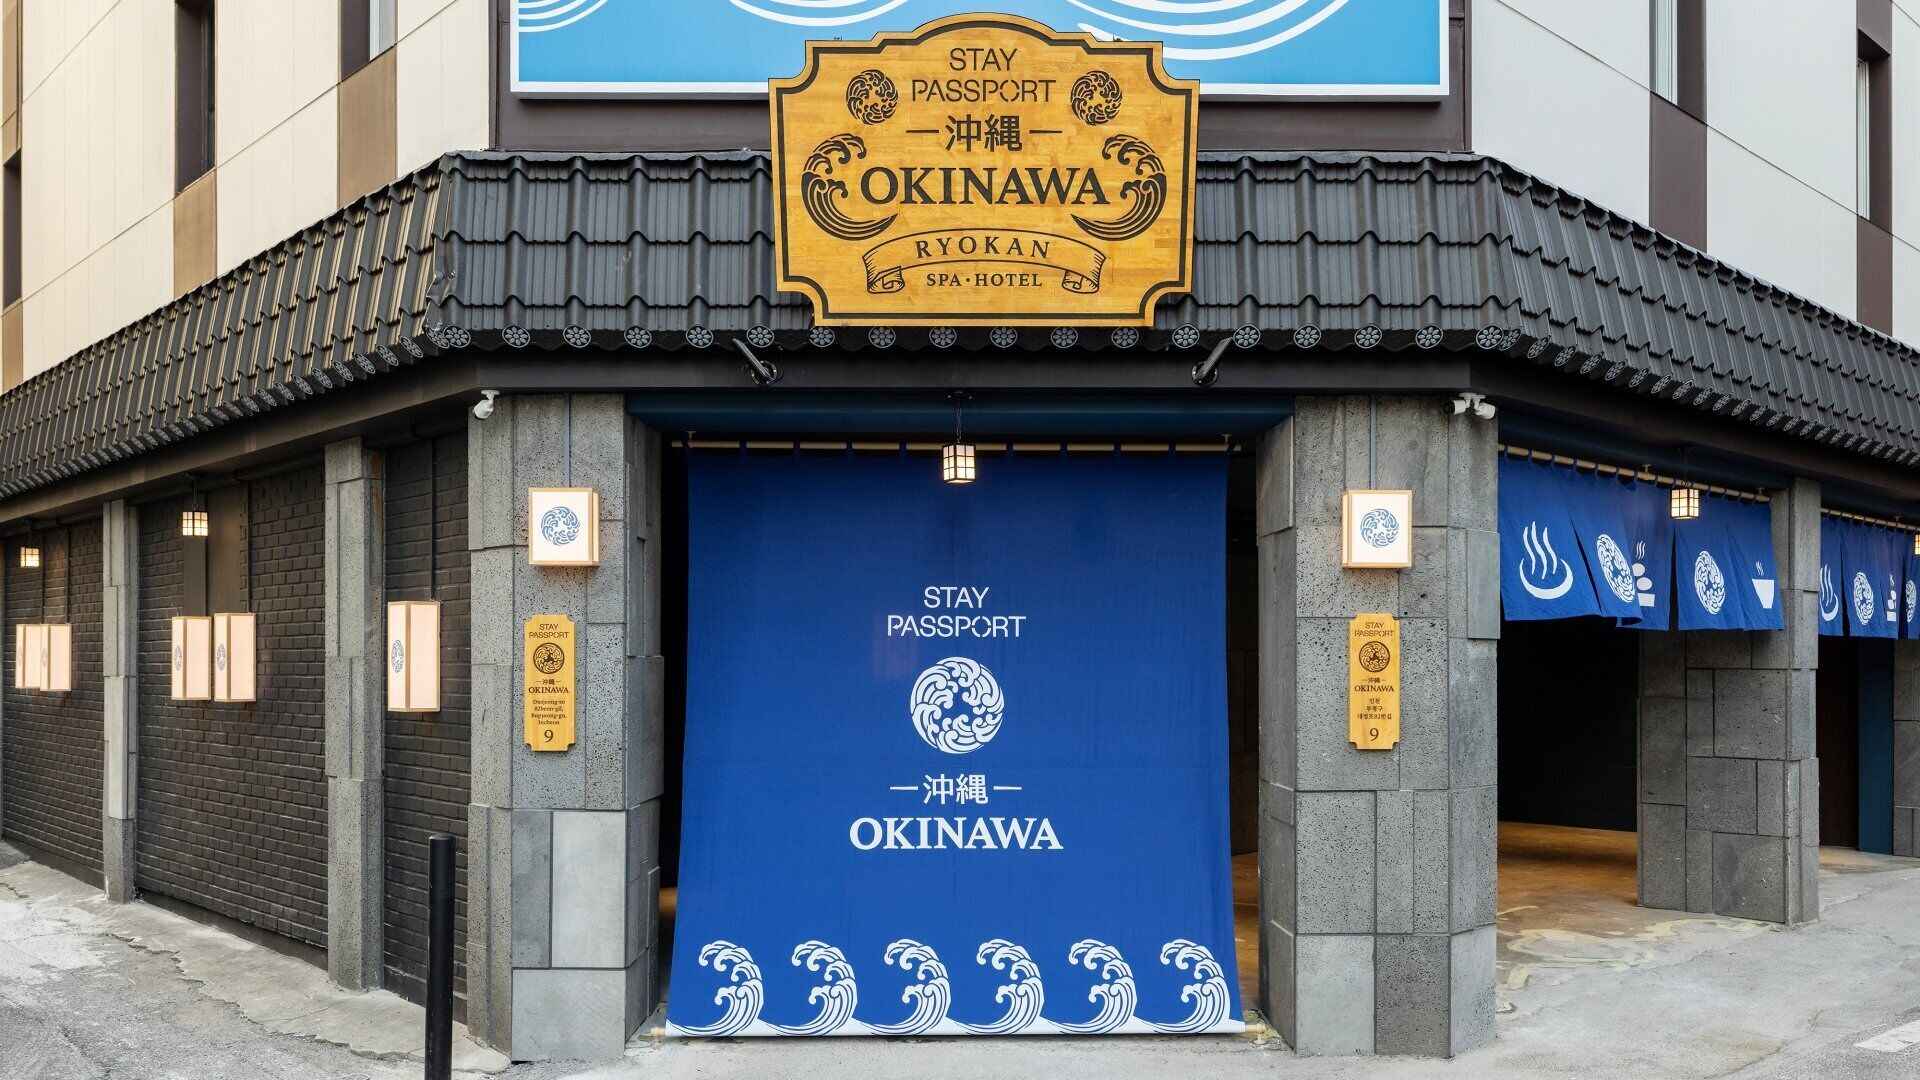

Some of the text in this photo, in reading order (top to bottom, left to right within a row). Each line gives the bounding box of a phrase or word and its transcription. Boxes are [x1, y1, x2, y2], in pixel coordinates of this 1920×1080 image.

[949, 47, 1018, 72] STAY
[911, 79, 1057, 103] PASSPORT
[945, 114, 1023, 152] 沖縄
[860, 166, 1111, 205] OKINAWA
[914, 236, 1051, 259] RYOKAN
[923, 586, 989, 609] STAY
[887, 615, 1027, 638] PASSPORT
[543, 729, 554, 743] 9
[1369, 727, 1380, 741] 9
[923, 773, 989, 805] 沖縄
[849, 817, 1064, 850] OKINAWA
